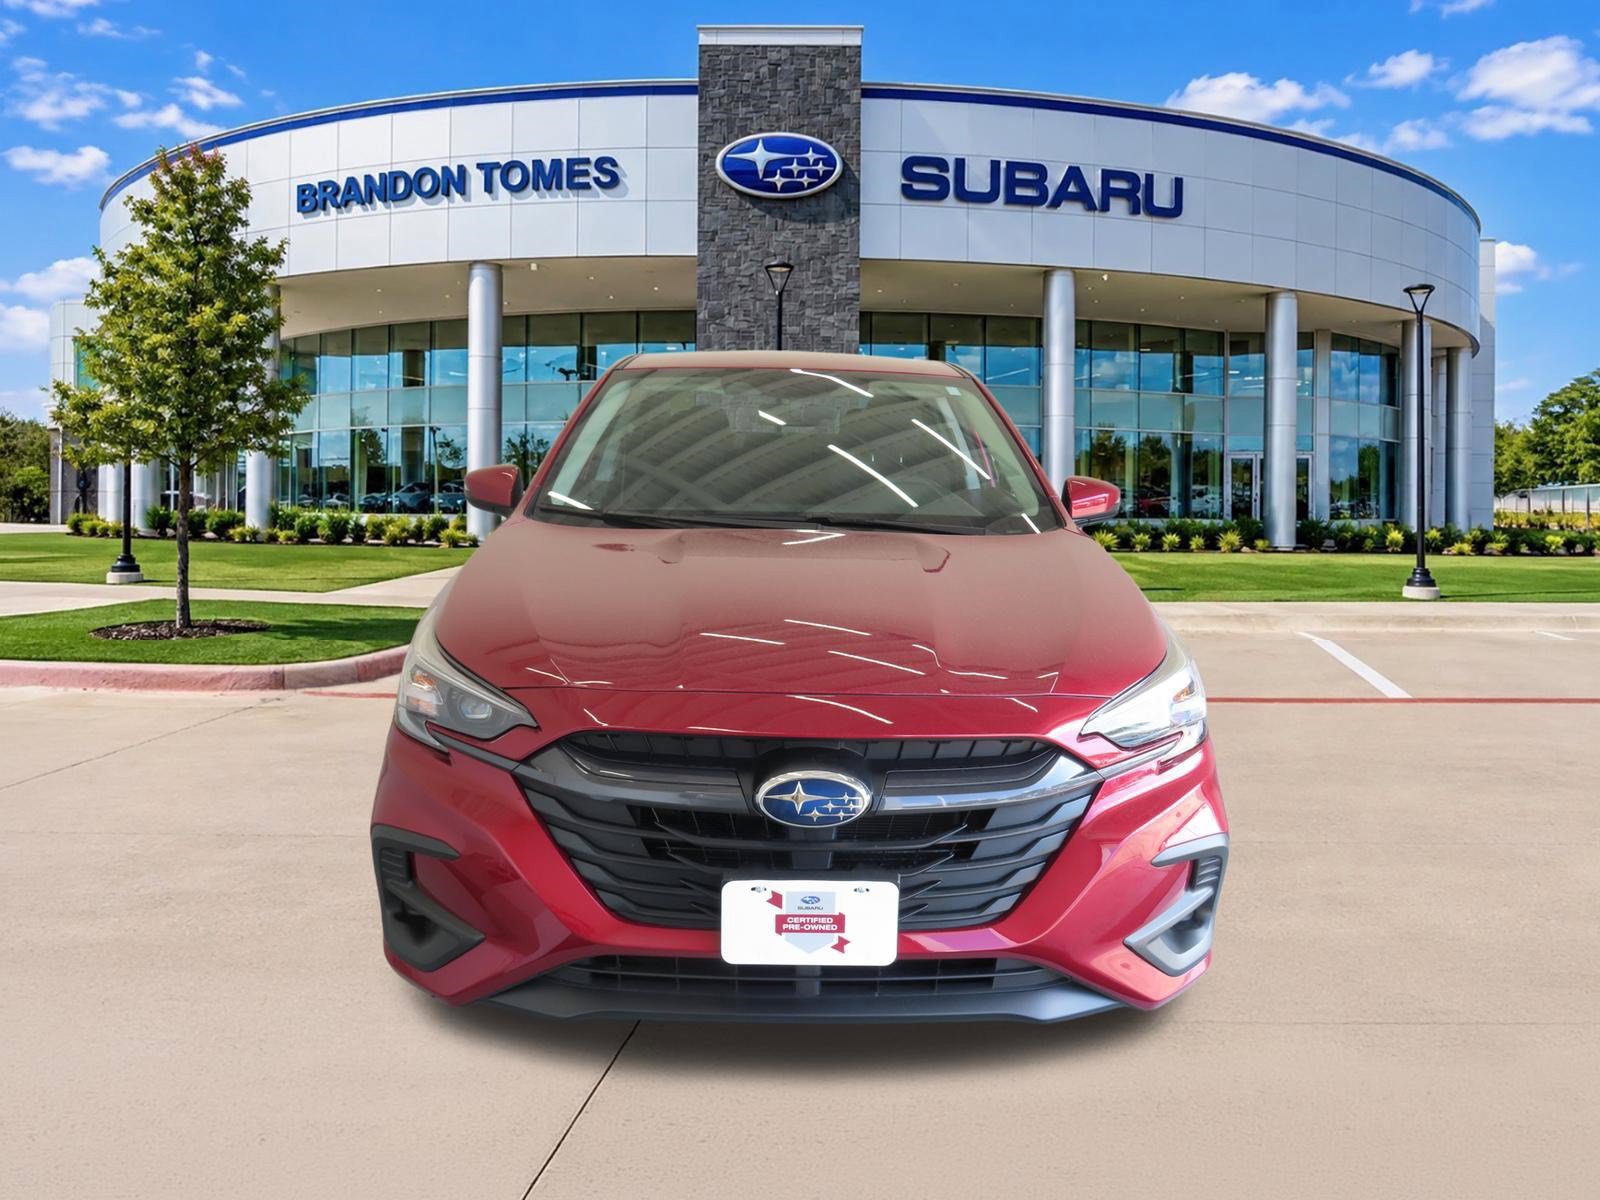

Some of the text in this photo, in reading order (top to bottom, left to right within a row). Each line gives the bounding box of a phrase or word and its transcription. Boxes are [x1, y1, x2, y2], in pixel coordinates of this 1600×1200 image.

[297, 156, 620, 213] BRANDON TOMES
[901, 155, 1183, 218] SUBARU
